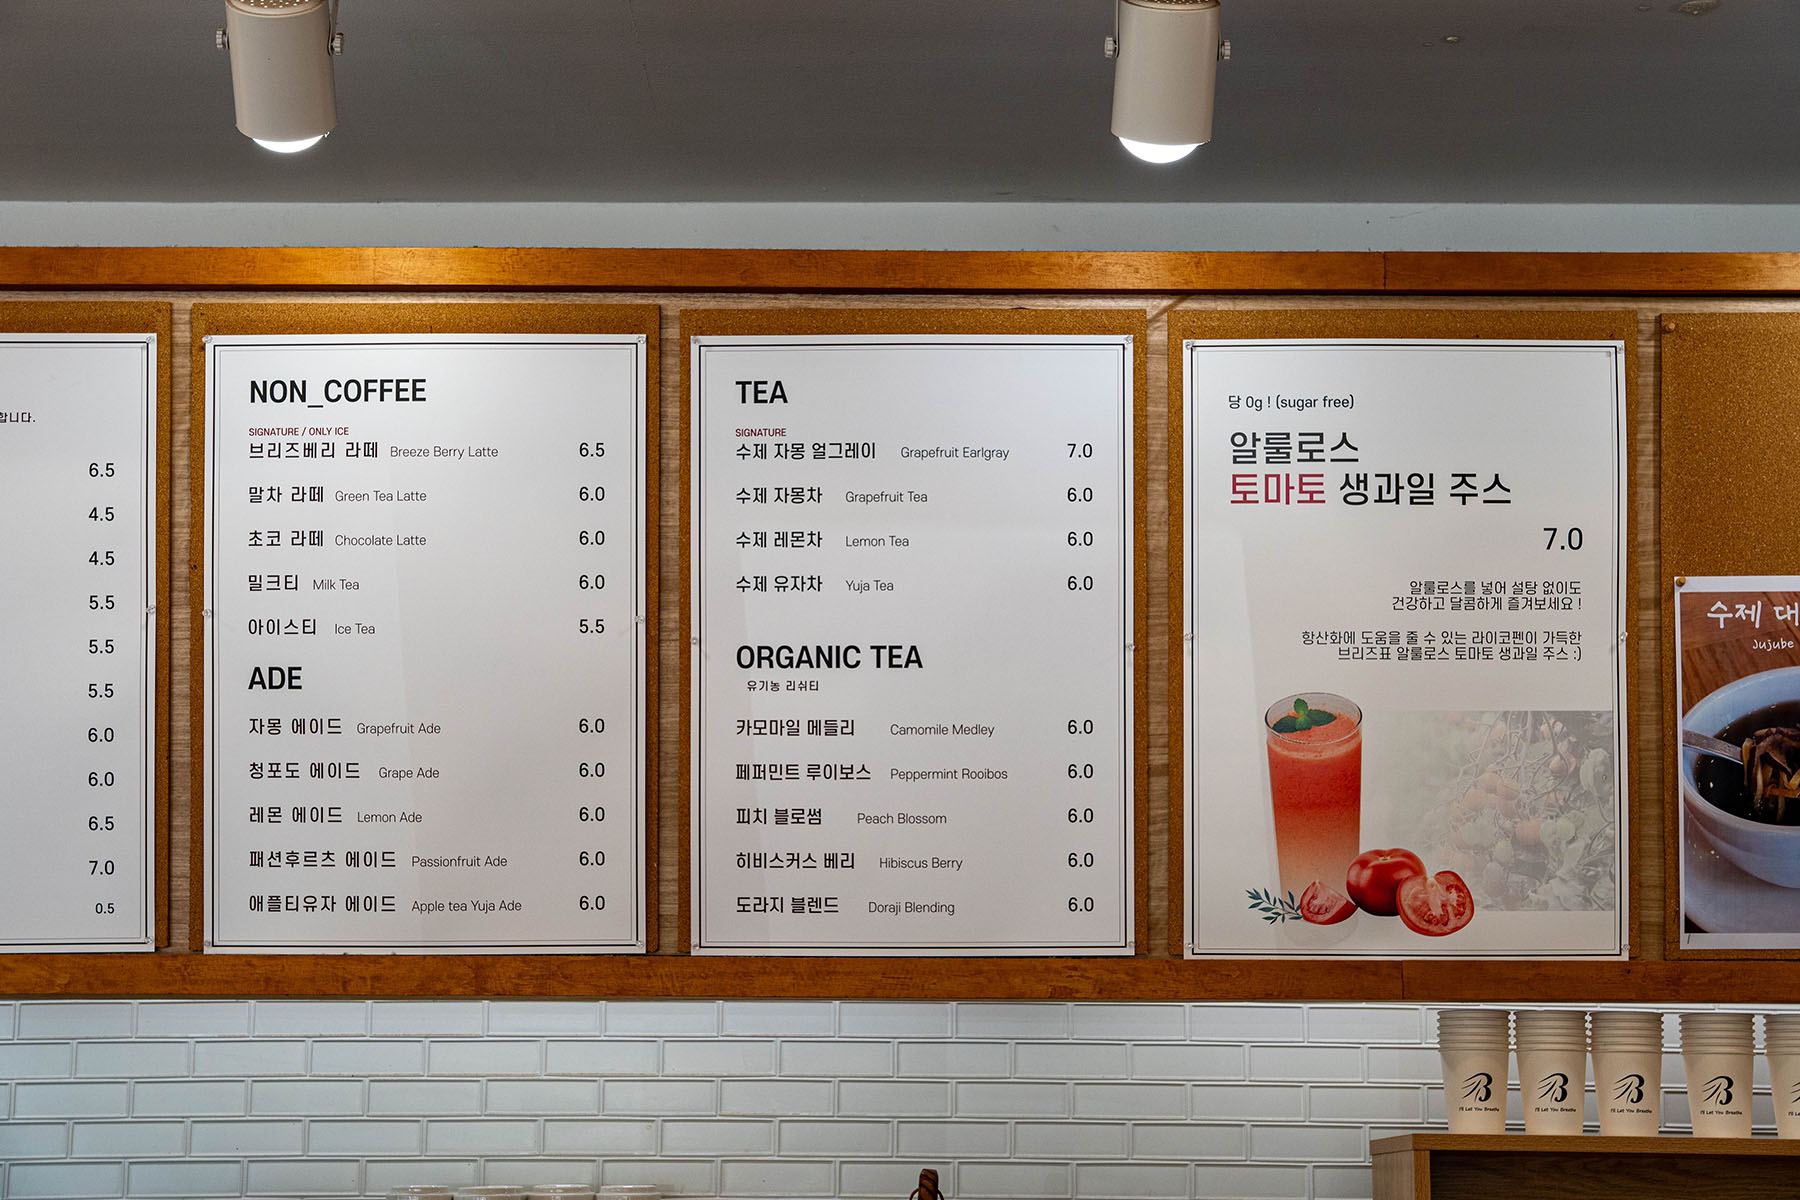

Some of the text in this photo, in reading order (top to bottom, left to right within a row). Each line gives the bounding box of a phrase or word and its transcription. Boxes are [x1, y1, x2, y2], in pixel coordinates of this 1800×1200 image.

[250, 379, 426, 408] NON_COFFEE
[735, 381, 788, 404] TEA
[1229, 394, 1354, 411] 당 0g (sugar free)
[249, 427, 349, 436] SIGNATURE ONLY ICE
[736, 428, 786, 437] SIGNATURE
[249, 442, 604, 460] 브리즈베리 라떼 Breeze Berry Latte 6.5
[736, 442, 1092, 461] 수제 자몽 얼그레이 Grapefruit Earlgray 7.0
[1231, 432, 1359, 464] 알룰로스
[89, 463, 114, 477] 6.5
[249, 486, 605, 503] 말차 라떼 Green Tea Latte 6.0
[736, 487, 1093, 505] 수제 자몽차 Grapefruit Tea 6.0
[1231, 473, 1511, 505] 토마토 생과일 주스
[248, 530, 605, 547] 초코 라떼 Chocolate Latte 6.0
[736, 531, 1093, 548] 수제 레몬차 Lemon Tea 6.0
[1544, 528, 1583, 550] 7.0
[249, 575, 605, 591] 밀크티 Milk Tea 6.0
[736, 575, 1093, 594] 수제 유자차 Yuja Tea 6.0
[1410, 581, 1581, 595] 알룰로스를 넣어 설탕 없이도
[89, 595, 114, 610] 5.5
[1393, 597, 1573, 610] 건강하고 달콤하게 즐겨보세요
[1707, 601, 1761, 628] 수제
[249, 619, 604, 635] 아이스티 Ice Tea 5.5
[1302, 631, 1582, 645] 항산화에 도움을 줄 수 있는 라이코펜이 가득한
[1753, 638, 1793, 651] Jujube
[737, 645, 923, 669] ORGANIC TEA
[1339, 647, 1568, 661] 브리즈표 알룰로스 토마토 생과일 주스
[248, 667, 302, 689] ADE
[747, 681, 818, 692] 유기농 리쉬티
[88, 728, 114, 742] 6.0
[249, 718, 604, 736] 자몽 에이드 Grapefruit Ade 6.0
[737, 720, 1093, 737] 카모마일 메들리 Camomile Medley 6.0
[250, 762, 605, 781] 청포도 에이드 Grape Ade 6.0
[736, 764, 1093, 782] 페퍼민트 루이보스 Peppermint Rooibos 6.0
[250, 807, 605, 823] 레몬 에이드 Lemon Ade 6.0
[736, 808, 1093, 825] 피치 블로썸 Peach Blossom 6.0
[89, 860, 114, 875] 7.0
[250, 850, 605, 868] 패션후르츠 에이드 Passionfruit Ade 6.0
[736, 852, 1093, 871] 히비스커스 베리 Hibiscus Berry 6.0
[96, 903, 114, 914] 0.5
[250, 895, 605, 914] 애플티유자 에이드 Apple tea Yuja Ade 6.0
[737, 897, 1094, 916] 도라지 블렌드 Doraji Blending 6.0
